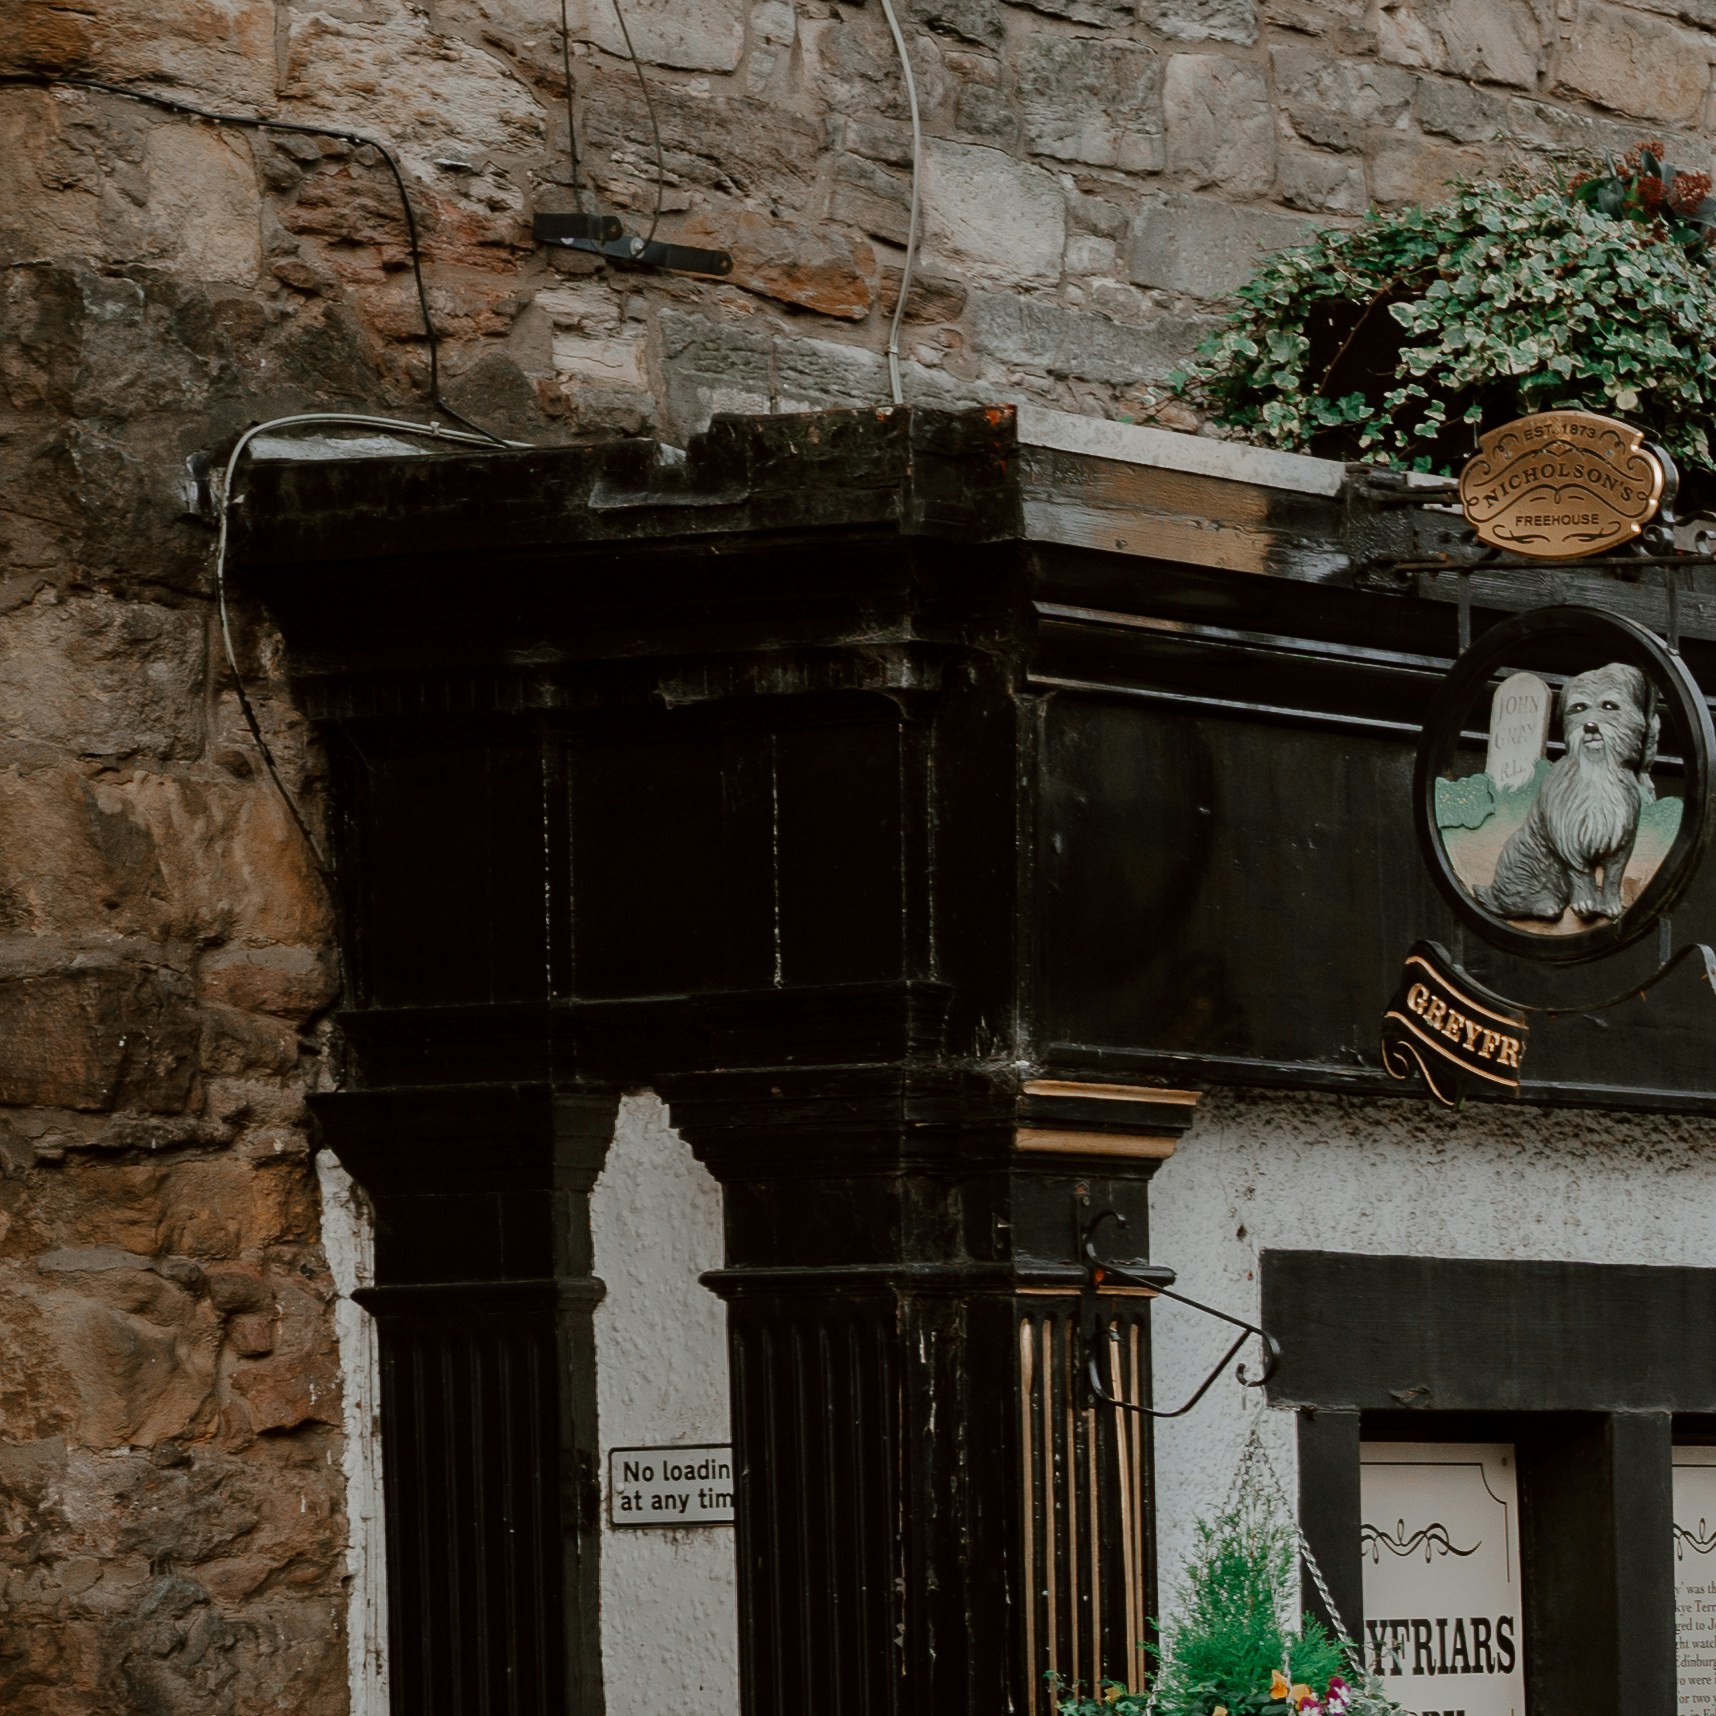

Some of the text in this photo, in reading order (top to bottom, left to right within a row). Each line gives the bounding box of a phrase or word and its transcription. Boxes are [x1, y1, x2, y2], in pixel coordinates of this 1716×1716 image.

[1523, 423, 1597, 441] EST. 1873
[1483, 462, 1635, 509] NICHOLSON'S
[1514, 513, 1601, 527] FREEHOUSE
[1497, 695, 1540, 725] JOHN
[1407, 982, 1520, 1068] GREYFR
[623, 1459, 730, 1482] No loadin
[621, 1487, 735, 1513] at any tim
[1686, 1585, 1705, 1594] was
[1675, 1601, 1692, 1617] kye
[1695, 1621, 1706, 1631] to
[1365, 1614, 1516, 1678] YFRIARS
[1687, 1677, 1712, 1685] were
[1692, 1695, 1711, 1703] two
